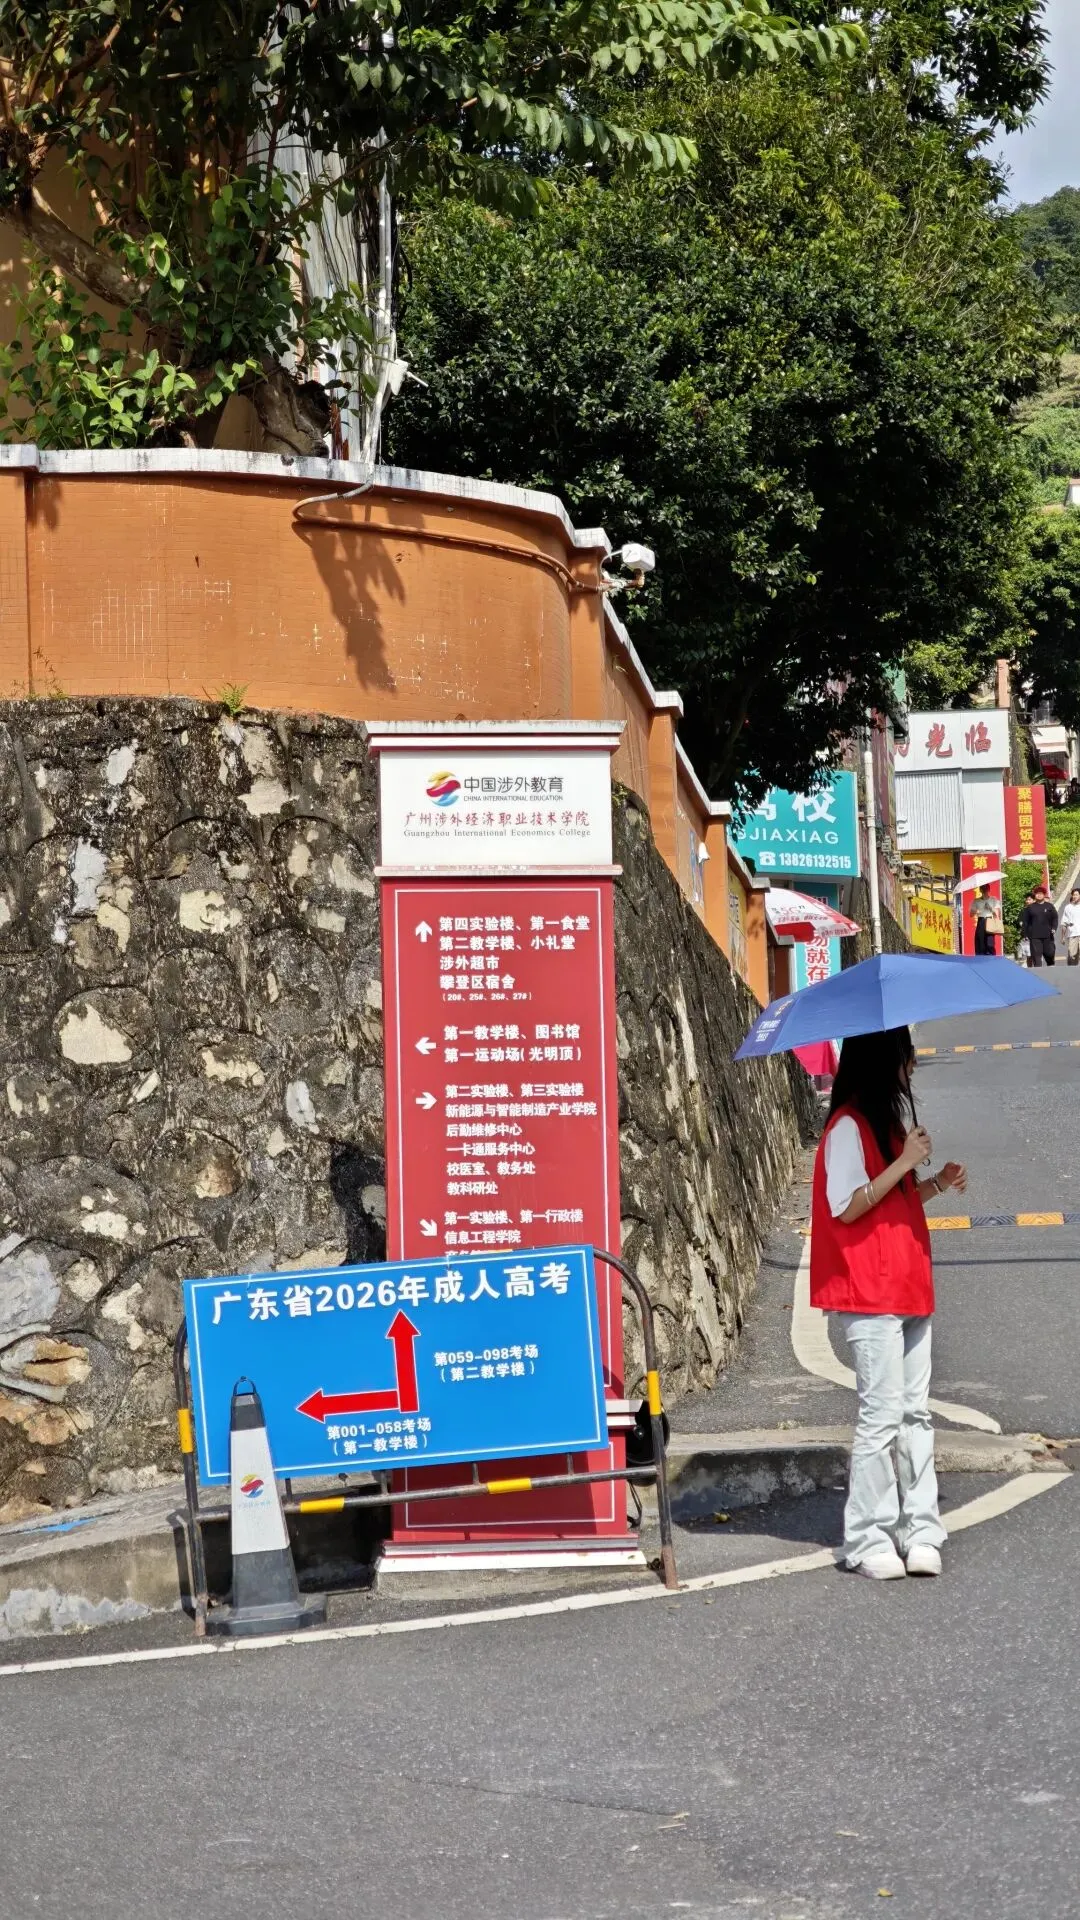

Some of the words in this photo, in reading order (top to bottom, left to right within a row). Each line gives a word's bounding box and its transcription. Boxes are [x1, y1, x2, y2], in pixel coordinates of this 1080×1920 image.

[463, 776, 564, 793] 中国涉外教育
[403, 811, 591, 827] 广州涉外经济职业技术学院
[1016, 787, 1035, 855] 聚膳园饭堂
[403, 829, 450, 839] Guangzhou
[454, 829, 507, 838] International
[511, 829, 556, 838] Economics
[559, 828, 592, 838] College
[779, 852, 852, 869] 13826132515
[439, 915, 591, 931] 第四实验楼、第一食堂
[439, 934, 576, 951] 第二教学楼、小礼堂
[439, 956, 500, 970] 涉外超市
[439, 974, 516, 990] 攀登区宿舍
[444, 1024, 580, 1040] 第一教学楼、图书馆
[445, 1082, 584, 1099] 第二实验楼、第三实验楼
[445, 1102, 598, 1117] 新能源与智能制造产业学院
[446, 1123, 522, 1137] 后勤维修中心
[446, 1142, 536, 1156] 一卡通服务中心
[446, 1161, 536, 1176] 校医室、教务处
[447, 1182, 499, 1195] 教科研处
[444, 1209, 583, 1225] 第一实验楼、第一行政楼
[444, 1230, 521, 1245] 信息工程学院
[211, 1262, 573, 1325] 广东省2026年成人高考
